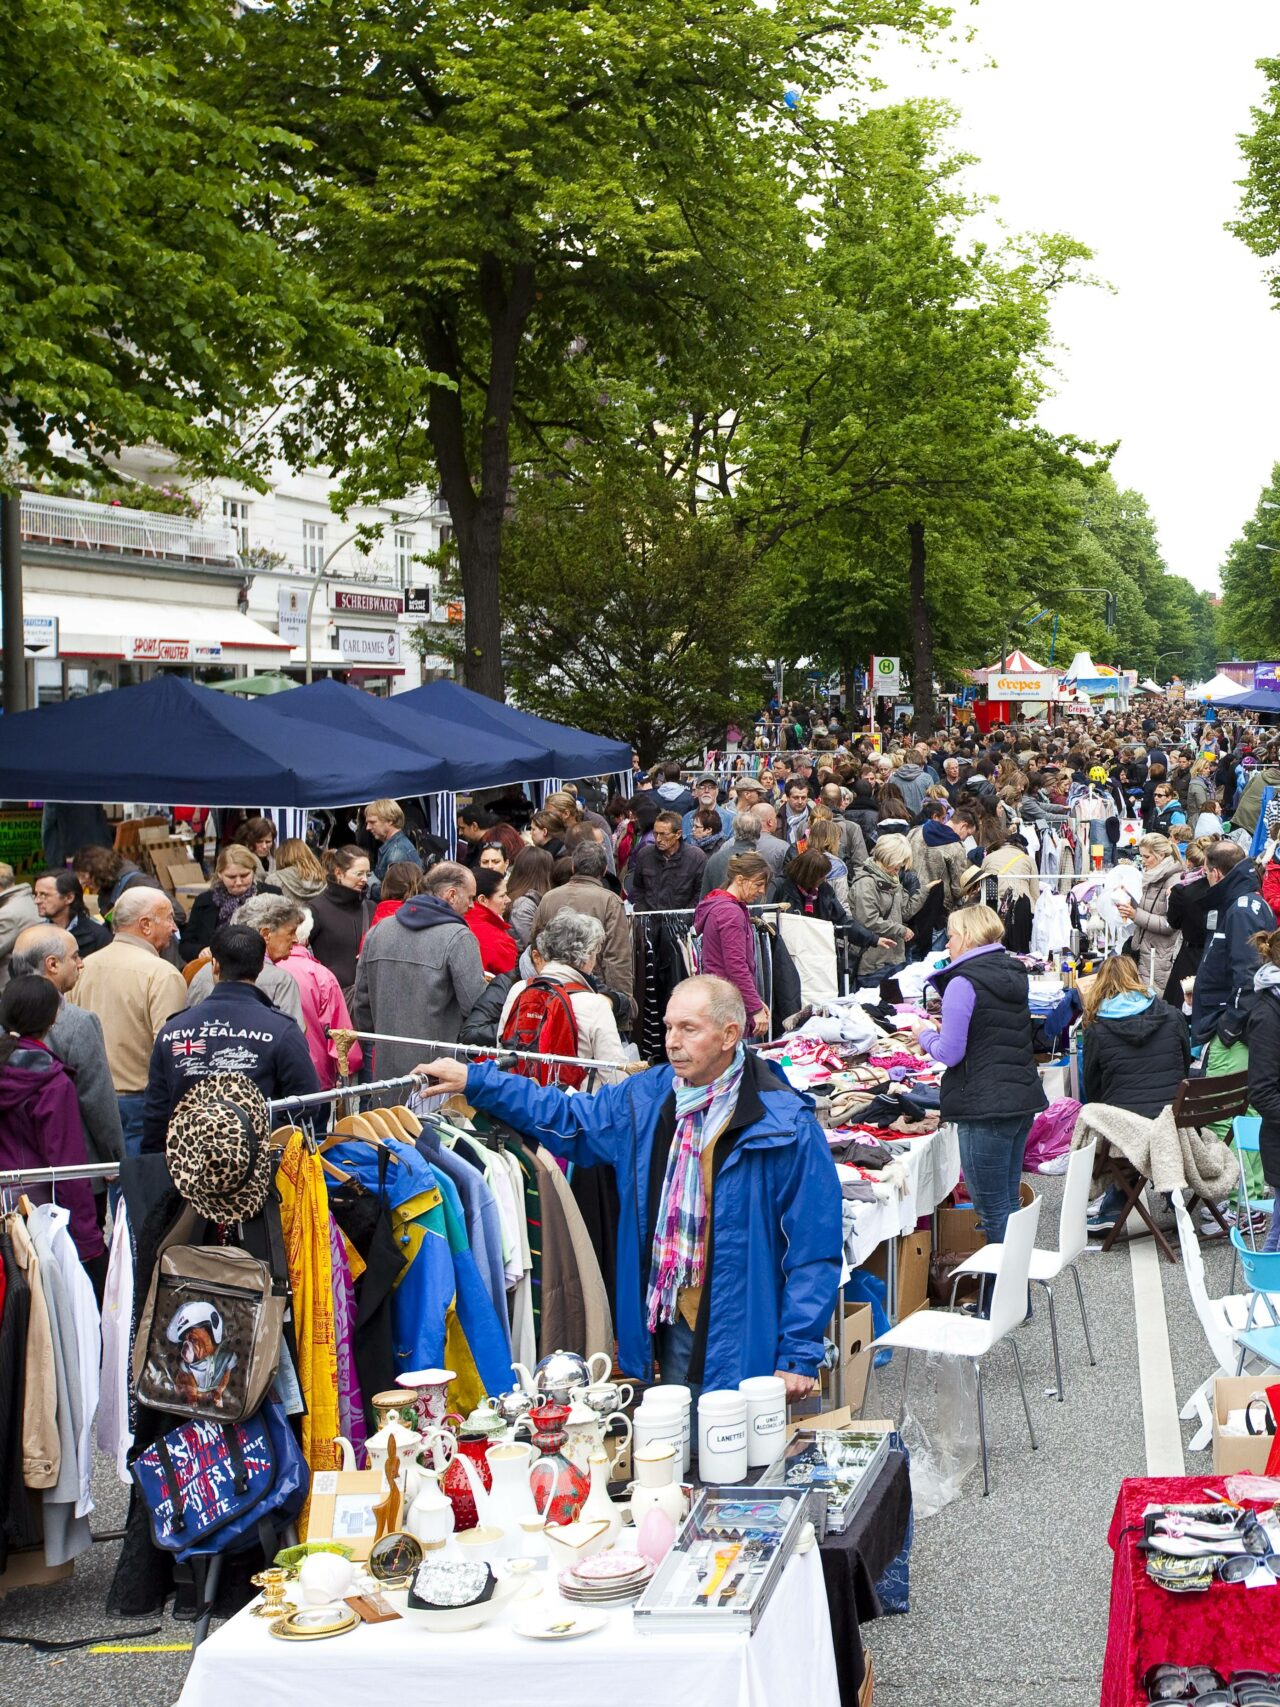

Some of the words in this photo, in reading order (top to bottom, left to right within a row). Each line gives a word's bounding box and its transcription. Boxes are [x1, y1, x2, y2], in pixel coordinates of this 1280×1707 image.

[341, 594, 398, 612] SCHREIBWAREN
[133, 637, 157, 653] SPORT
[342, 639, 360, 654] CARL
[361, 640, 385, 655] DAMES
[997, 677, 1041, 691] Crepes
[163, 1028, 196, 1042] NEW
[199, 1026, 274, 1043] ZEALAND
